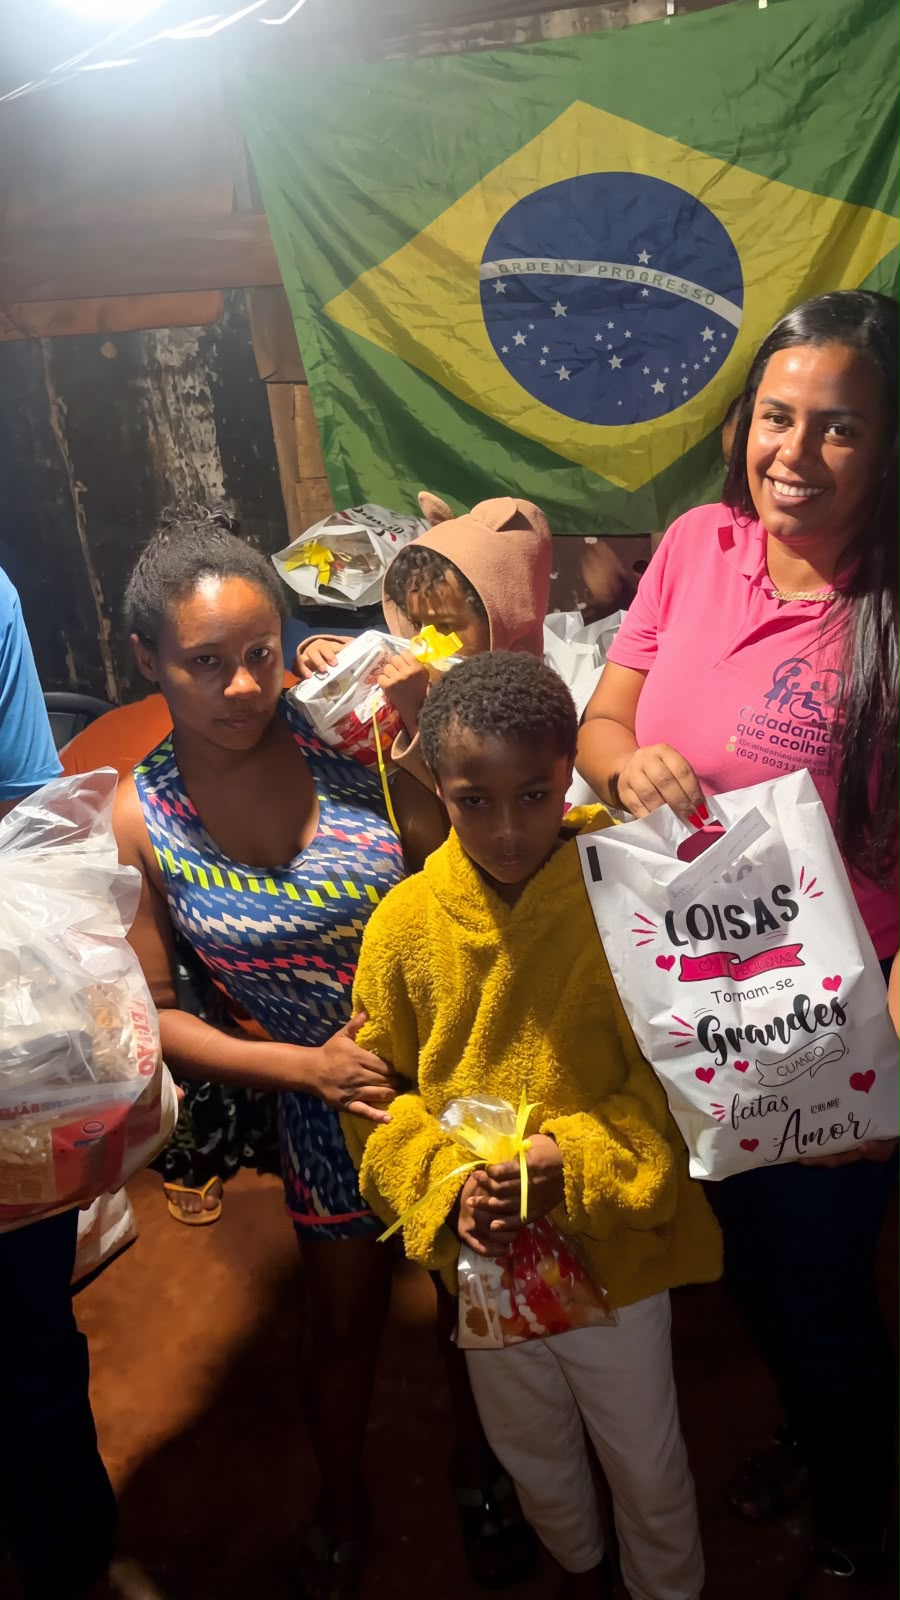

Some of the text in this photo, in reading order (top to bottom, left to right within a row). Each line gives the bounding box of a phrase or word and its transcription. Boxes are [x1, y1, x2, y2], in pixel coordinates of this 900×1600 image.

[597, 264, 716, 306] PROGRESSO
[735, 747, 759, 763] (62)
[736, 723, 766, 740] que
[769, 732, 828, 757] acolhe
[710, 978, 795, 1005] Tornam-se
[697, 993, 849, 1067] Grandes
[764, 1108, 871, 1162] Amor
